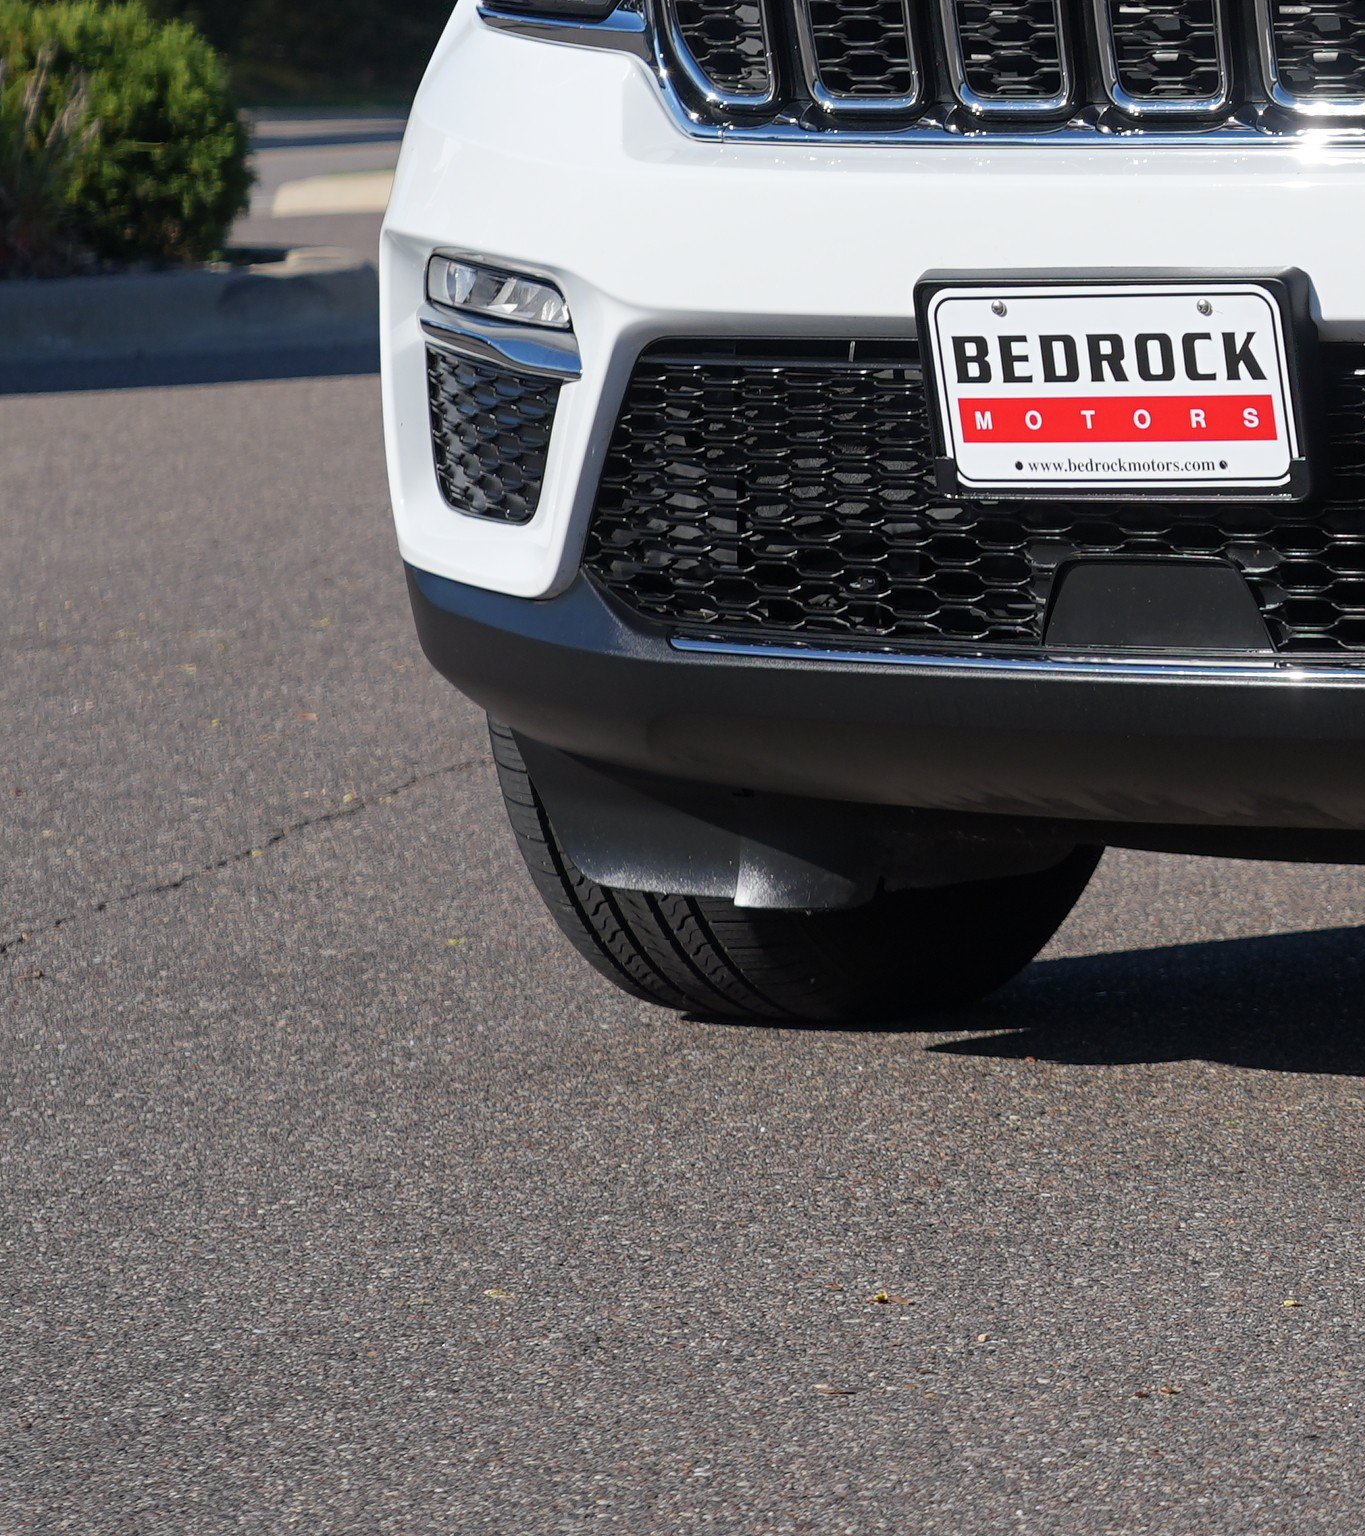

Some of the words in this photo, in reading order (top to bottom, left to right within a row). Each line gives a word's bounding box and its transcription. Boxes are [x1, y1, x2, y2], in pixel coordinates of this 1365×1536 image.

[951, 331, 1268, 384] BEDROCK
[974, 407, 1260, 431] MOTORS
[1027, 458, 1216, 473] www.bedrockmotors.com
